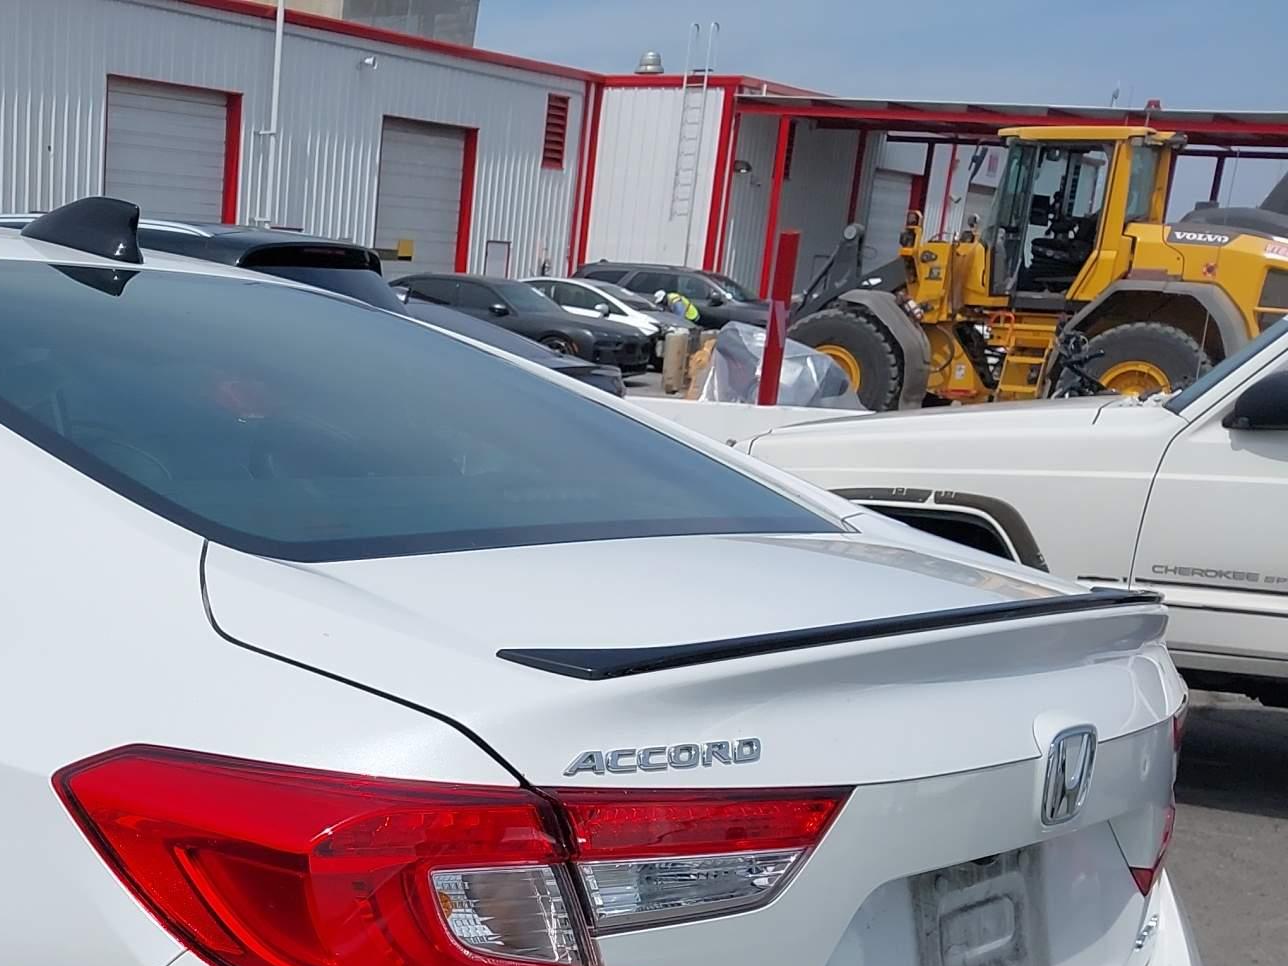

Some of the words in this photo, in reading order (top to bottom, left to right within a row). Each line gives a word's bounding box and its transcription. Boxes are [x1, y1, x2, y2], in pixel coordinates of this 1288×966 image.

[1174, 231, 1229, 243] VOLVO
[1151, 564, 1260, 583] CHEROKEE
[563, 738, 761, 776] ACCORD
